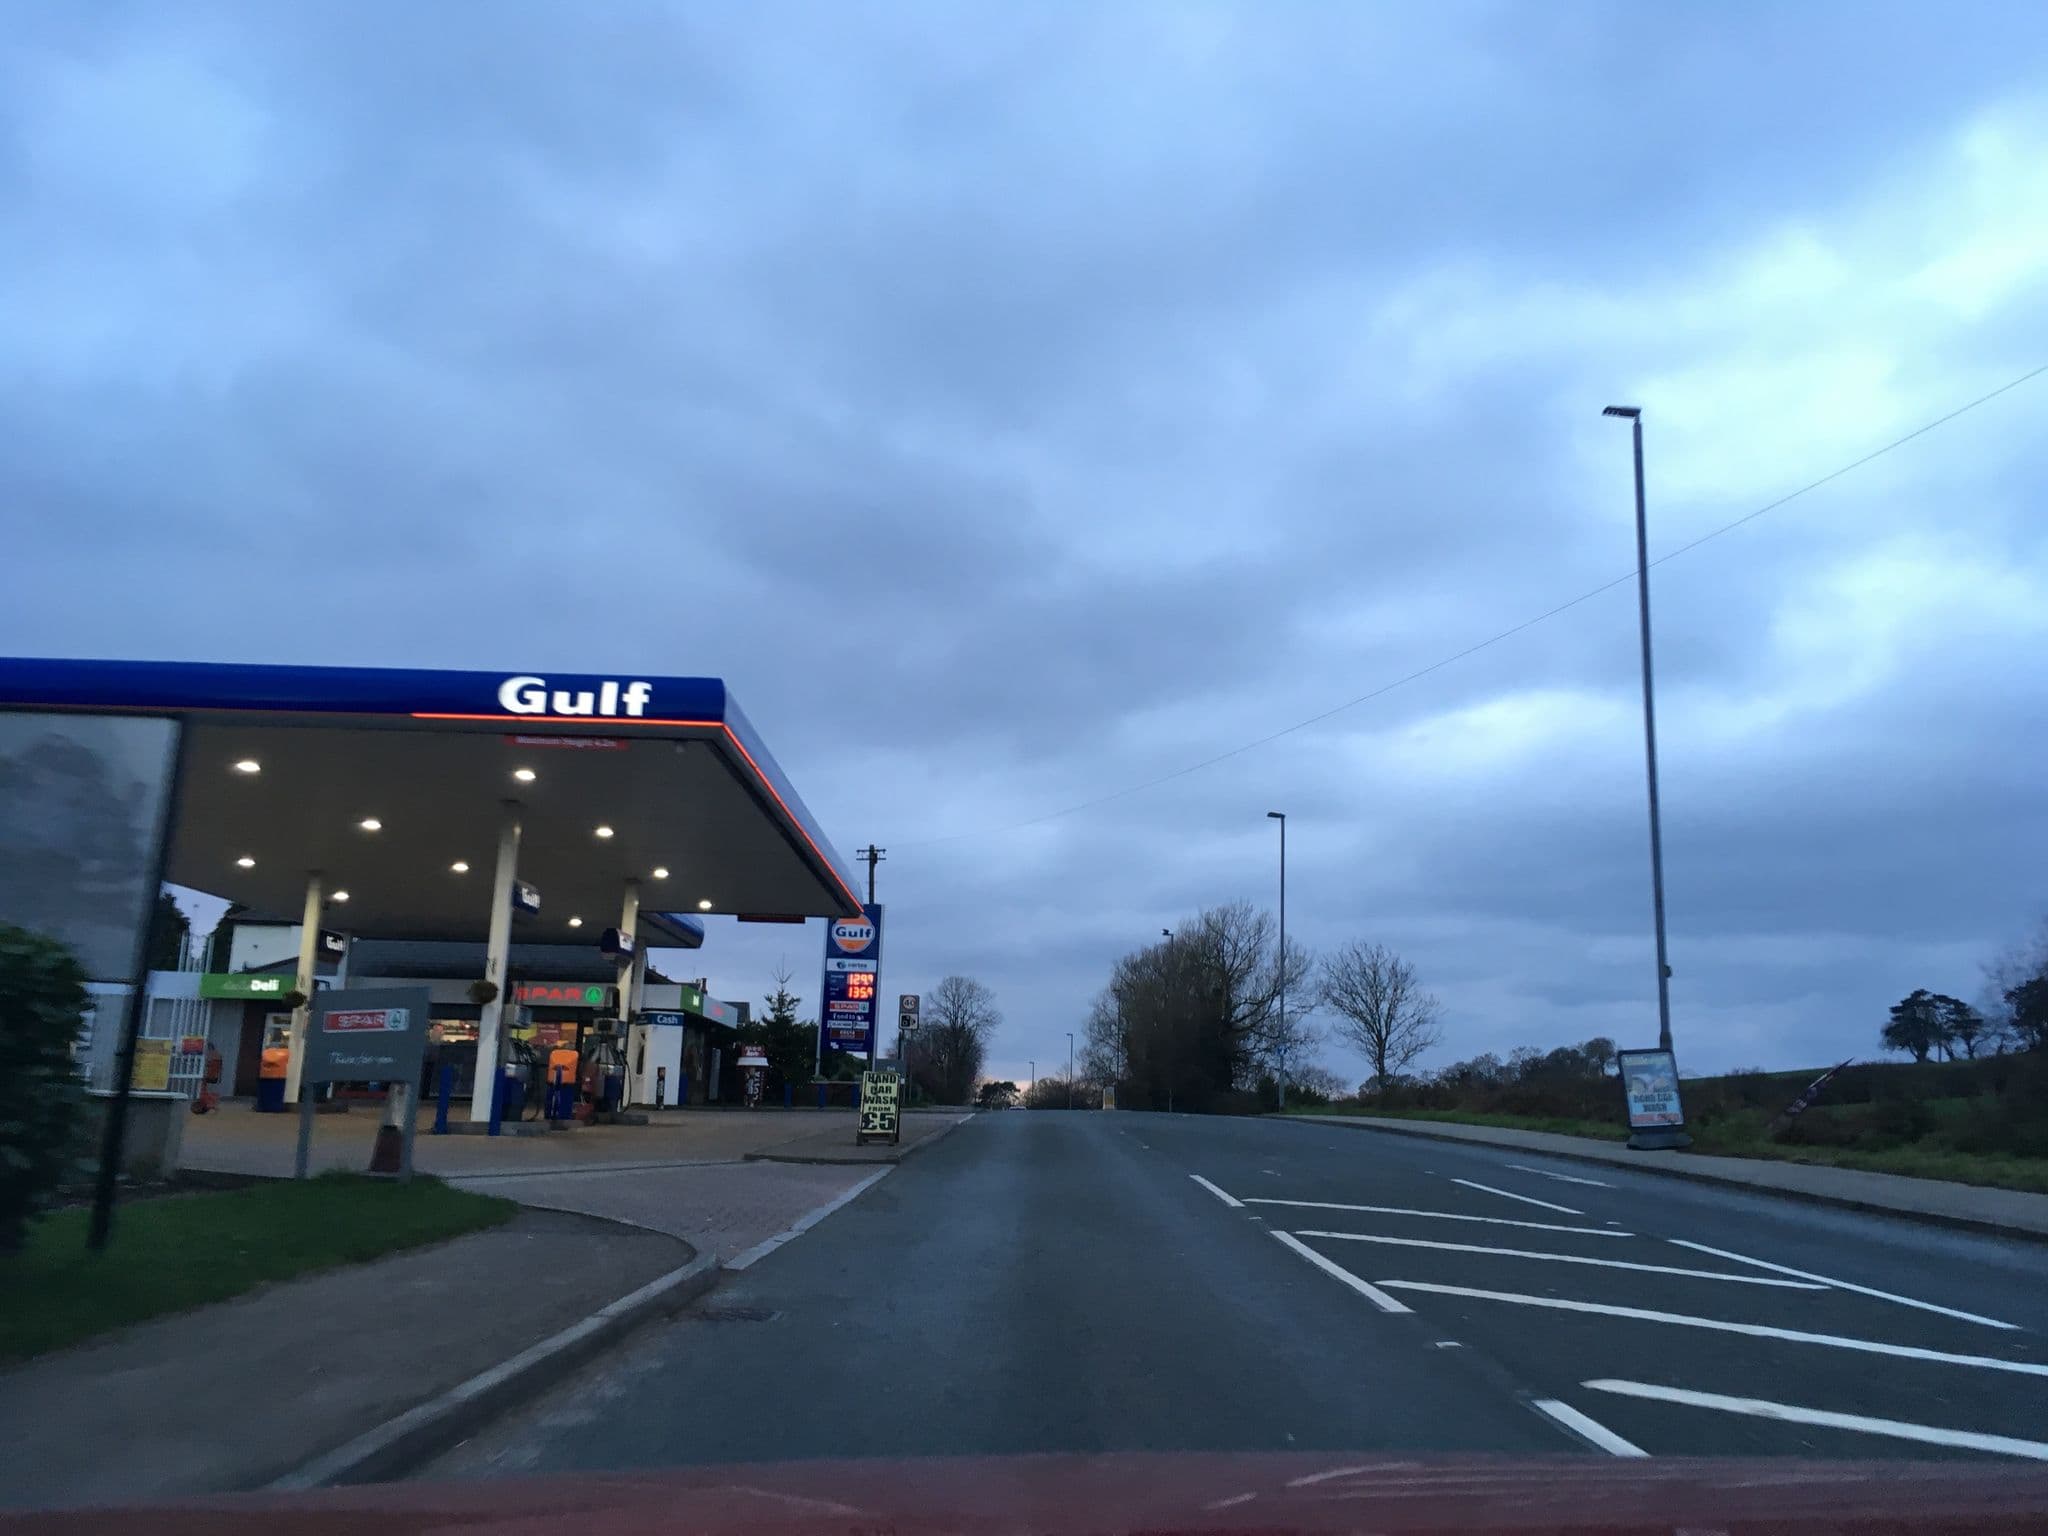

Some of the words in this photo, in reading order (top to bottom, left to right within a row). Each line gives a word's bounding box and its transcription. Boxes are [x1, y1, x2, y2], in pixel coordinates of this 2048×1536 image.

[498, 676, 653, 717] Gulf
[835, 926, 873, 938] Gulf
[251, 979, 280, 991] Deli
[656, 1015, 679, 1024] Cash
[867, 1073, 897, 1083] HAND
[870, 1085, 892, 1095] CAR
[864, 1096, 897, 1104] WASH
[863, 1112, 895, 1130] £5
